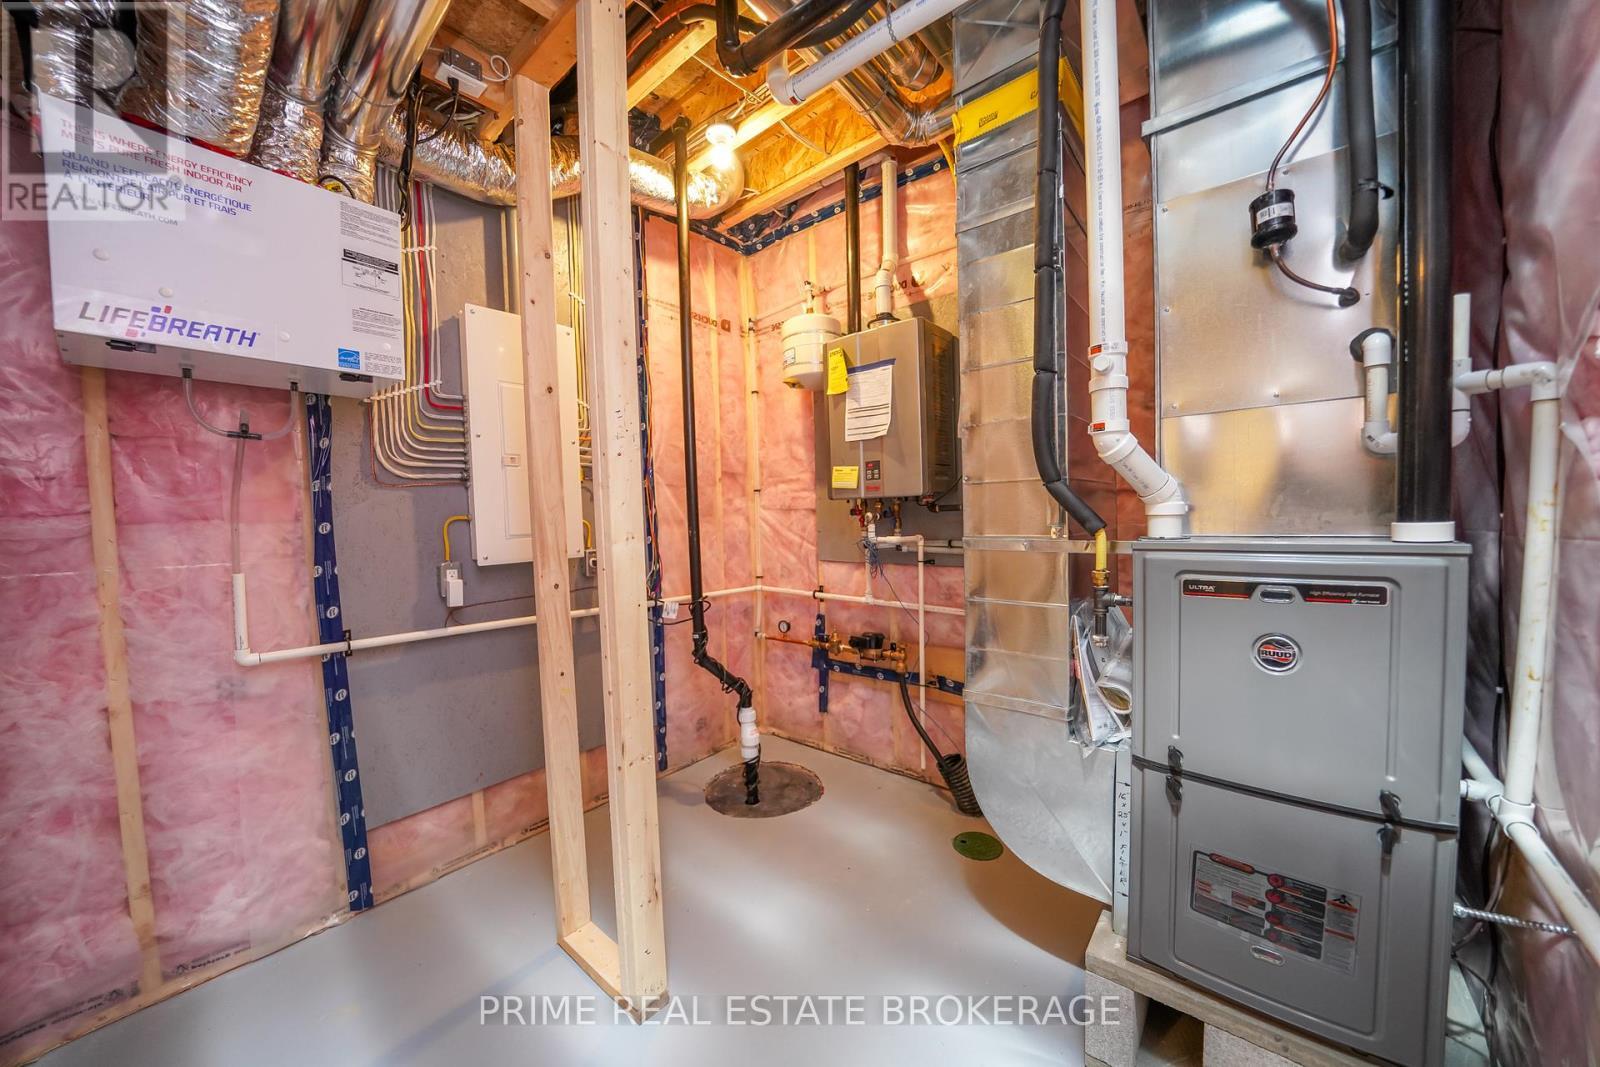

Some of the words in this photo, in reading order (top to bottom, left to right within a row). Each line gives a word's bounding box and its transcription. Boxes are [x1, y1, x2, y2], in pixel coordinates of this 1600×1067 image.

[61, 119, 90, 135] THIS
[94, 128, 106, 140] IS
[108, 134, 153, 155] WHERE
[155, 150, 197, 169] ENERGY
[200, 164, 253, 187] EFFICIENCY
[61, 129, 105, 150] MEETS
[144, 155, 180, 174] FRESH
[183, 169, 224, 187] INDOOR
[226, 181, 242, 193] AIR
[62, 149, 110, 169] QUAND
[183, 183, 253, 212] ÉNERGÉTIQUE
[62, 159, 137, 188] RENCONTRE
[168, 190, 191, 203] PUR
[194, 197, 206, 207] ET
[209, 202, 237, 216] FRAIS
[79, 301, 258, 347] LIFEBREATH
[1261, 649, 1291, 658] RUUD
